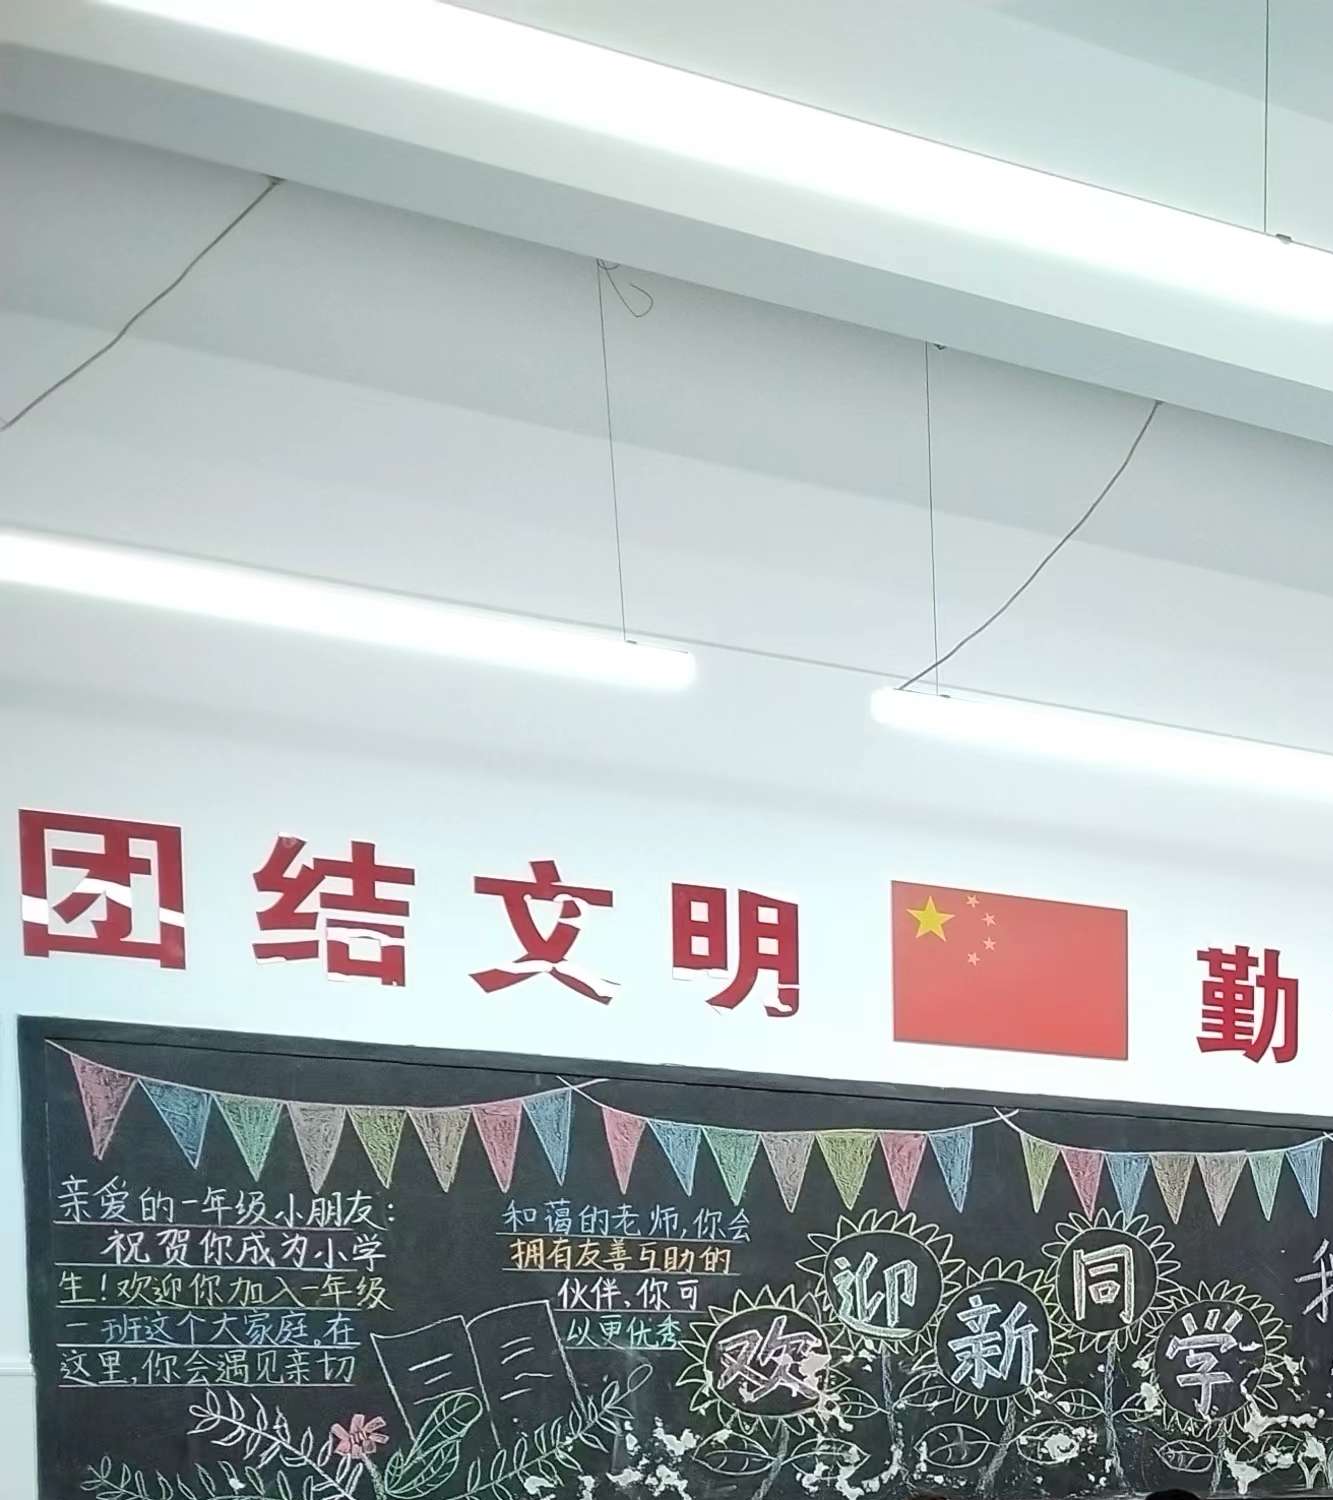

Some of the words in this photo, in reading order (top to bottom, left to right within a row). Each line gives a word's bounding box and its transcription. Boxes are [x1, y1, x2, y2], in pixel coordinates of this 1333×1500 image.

[18, 808, 800, 1018] 团结文明
[100, 1229, 386, 1272] 祝贺你成为小学
[509, 1237, 732, 1275] 拥有友善互助的
[566, 1314, 681, 1349] 以更优秀
